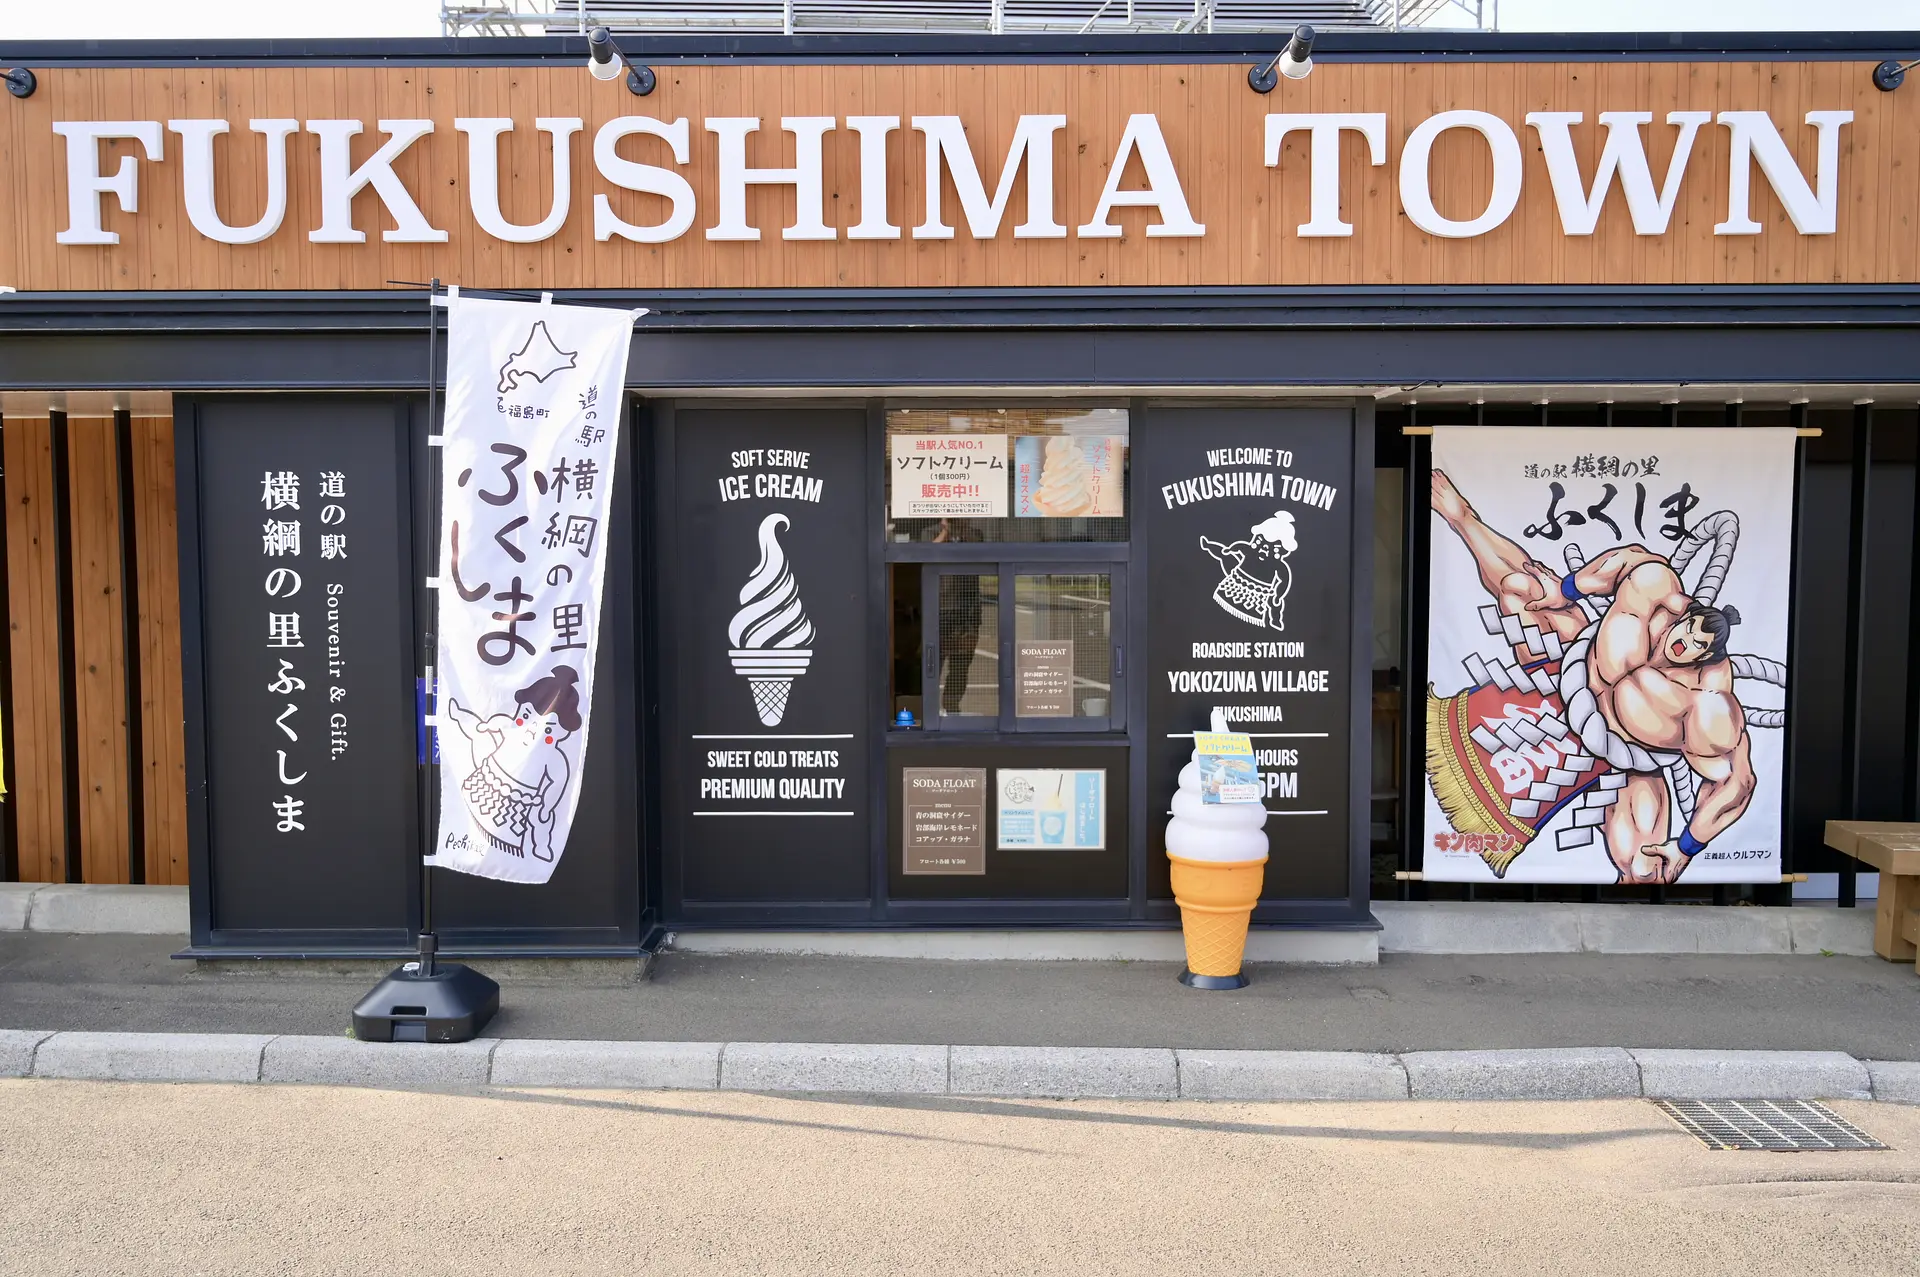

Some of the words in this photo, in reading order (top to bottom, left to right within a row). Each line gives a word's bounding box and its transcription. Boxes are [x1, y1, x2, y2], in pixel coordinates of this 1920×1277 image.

[53, 114, 1206, 246] FUKUSHIMA
[1264, 109, 1854, 238] TOWN
[508, 404, 551, 420] 福島町
[575, 384, 606, 448] 道の駅
[915, 439, 984, 451] 当駅人気NO.1
[732, 450, 764, 468] SOFT
[768, 449, 810, 469] SERVE
[896, 455, 1004, 470] ソフトクリーム
[1207, 448, 1272, 467] WELCOME
[1276, 450, 1292, 467] TO
[1524, 463, 1568, 479] 道の駅
[1571, 453, 1661, 479] 横綱の里
[719, 475, 750, 501] ICE
[755, 474, 823, 502] CREAM
[1019, 463, 1031, 515] 超オススメ
[1092, 445, 1101, 515] ソフトクリーム
[1162, 472, 1274, 509] FUKUSHIMA
[1278, 475, 1337, 511] TOWN
[320, 471, 347, 559] 道の駅
[1523, 482, 1700, 541] ふくしま
[450, 442, 549, 666] ふくしま
[540, 456, 599, 653] 横綱の里
[327, 584, 345, 677] Souvenir
[261, 472, 307, 832] 横綱の里ふくしま
[1021, 648, 1042, 656] SODA
[1042, 648, 1067, 656] FLOAT
[1193, 642, 1251, 658] ROADSIDE
[1254, 642, 1304, 658] STATION
[1168, 671, 1257, 692] YOKOZUNA
[1261, 671, 1328, 692] VILLAGE
[330, 686, 345, 702] &
[1212, 706, 1283, 722] UKUSHIMA
[331, 713, 347, 760] Gift.
[708, 751, 751, 767] SWEET
[754, 751, 787, 767] COLD
[790, 751, 838, 767] TREATS
[1255, 749, 1299, 767] HOURS
[702, 779, 775, 798] PREMIUM
[780, 779, 845, 799] QUALITY
[913, 779, 941, 788] SODA
[943, 779, 977, 788] FLOAT
[1434, 833, 1516, 853] キン肉マン
[1704, 852, 1732, 860] 正義超人
[1733, 850, 1772, 860] ウルフマン
